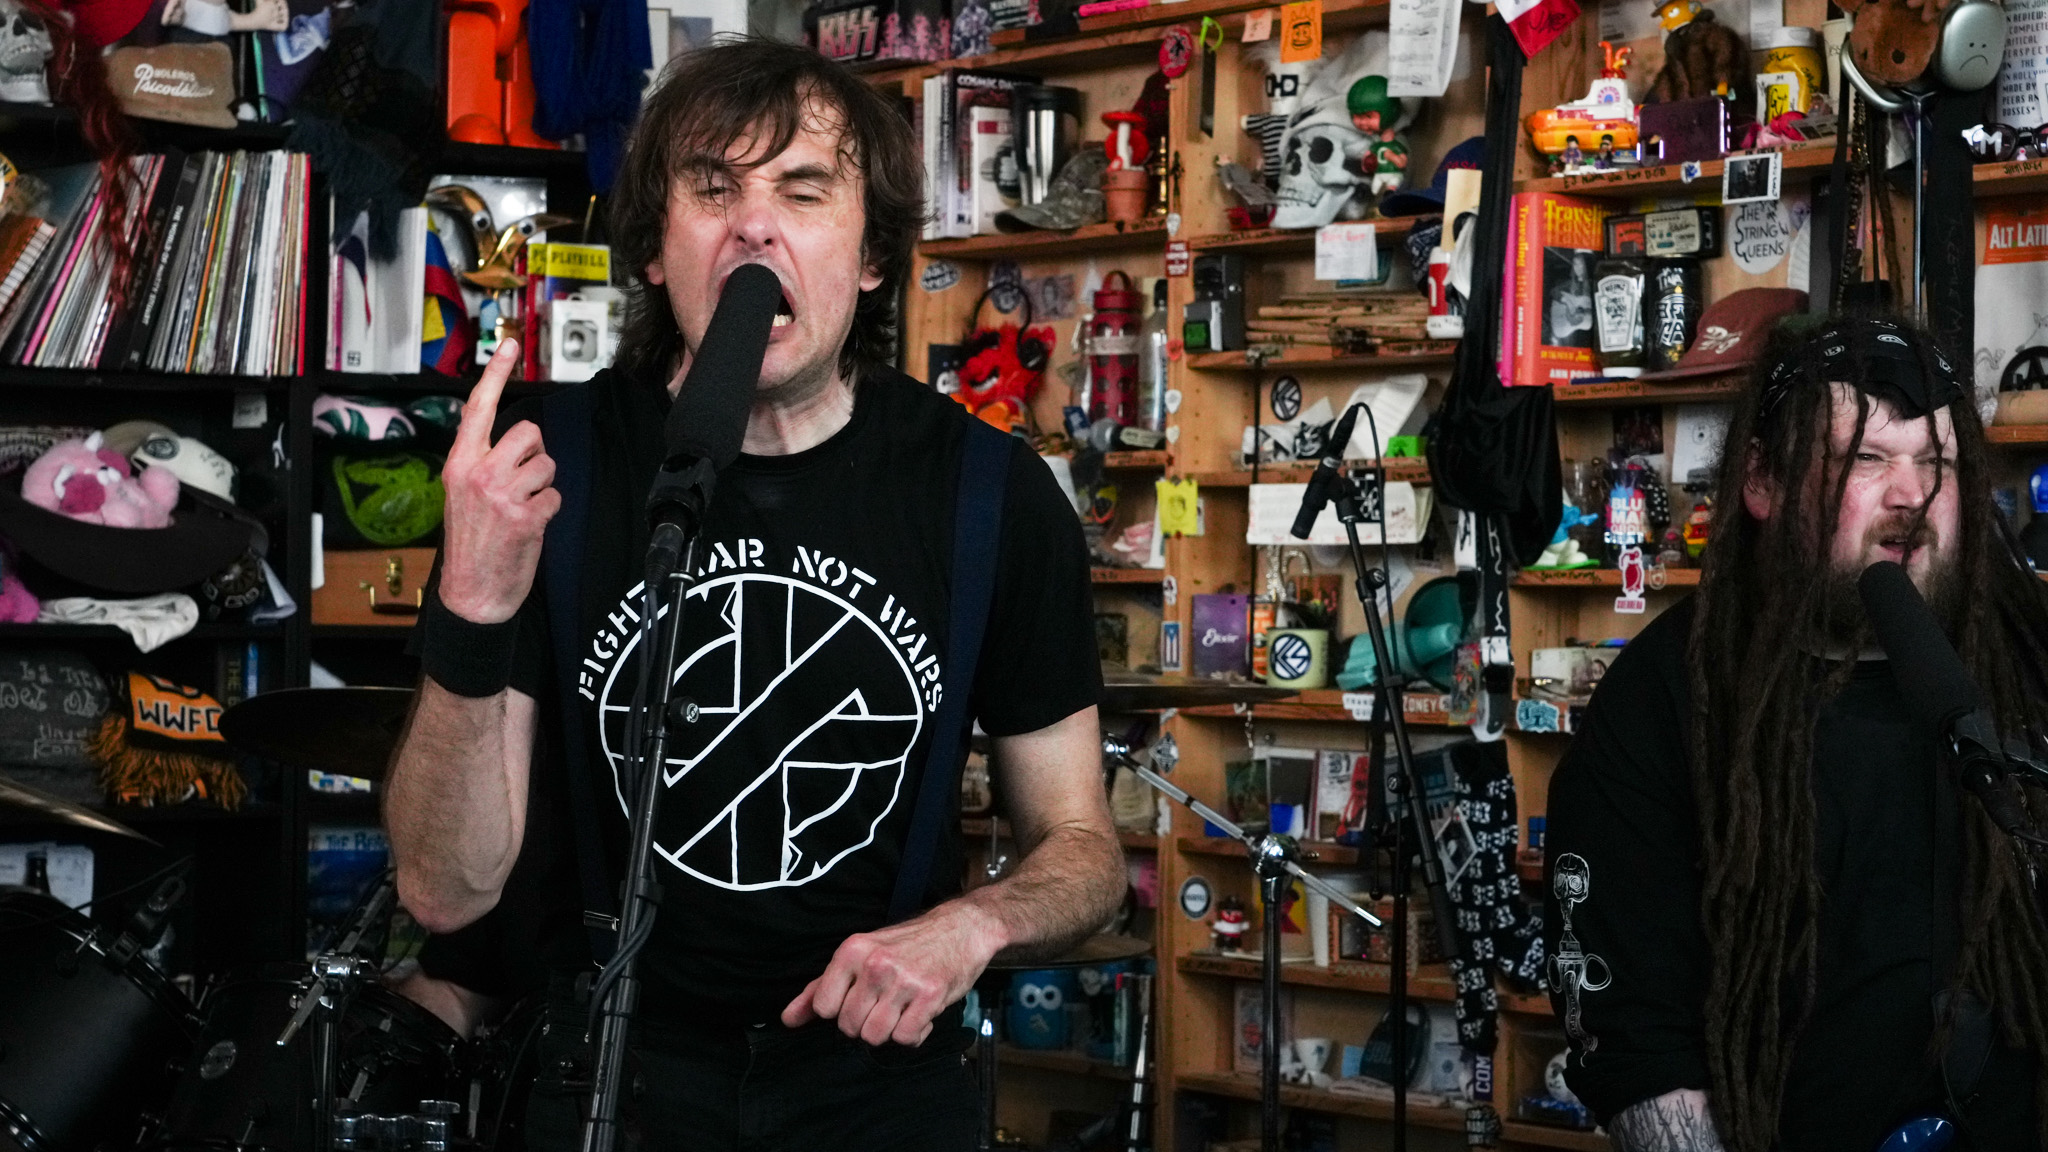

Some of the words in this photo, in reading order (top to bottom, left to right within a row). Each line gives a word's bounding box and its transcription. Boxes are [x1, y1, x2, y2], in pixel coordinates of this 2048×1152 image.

[819, 4, 880, 61] KISS
[2003, 83, 2022, 94] MADE
[2003, 95, 2025, 106] PEERS
[1740, 204, 1761, 222] THE
[1736, 215, 1778, 244] STRING
[551, 252, 606, 267] PLAYBILL
[1734, 240, 1784, 263] QUEENS
[698, 537, 766, 578] AR
[792, 545, 878, 601] NOT
[879, 594, 945, 713] WARS
[1202, 628, 1240, 648] Elixir
[137, 697, 224, 734] WWFC
[1474, 1054, 1493, 1095] COM
